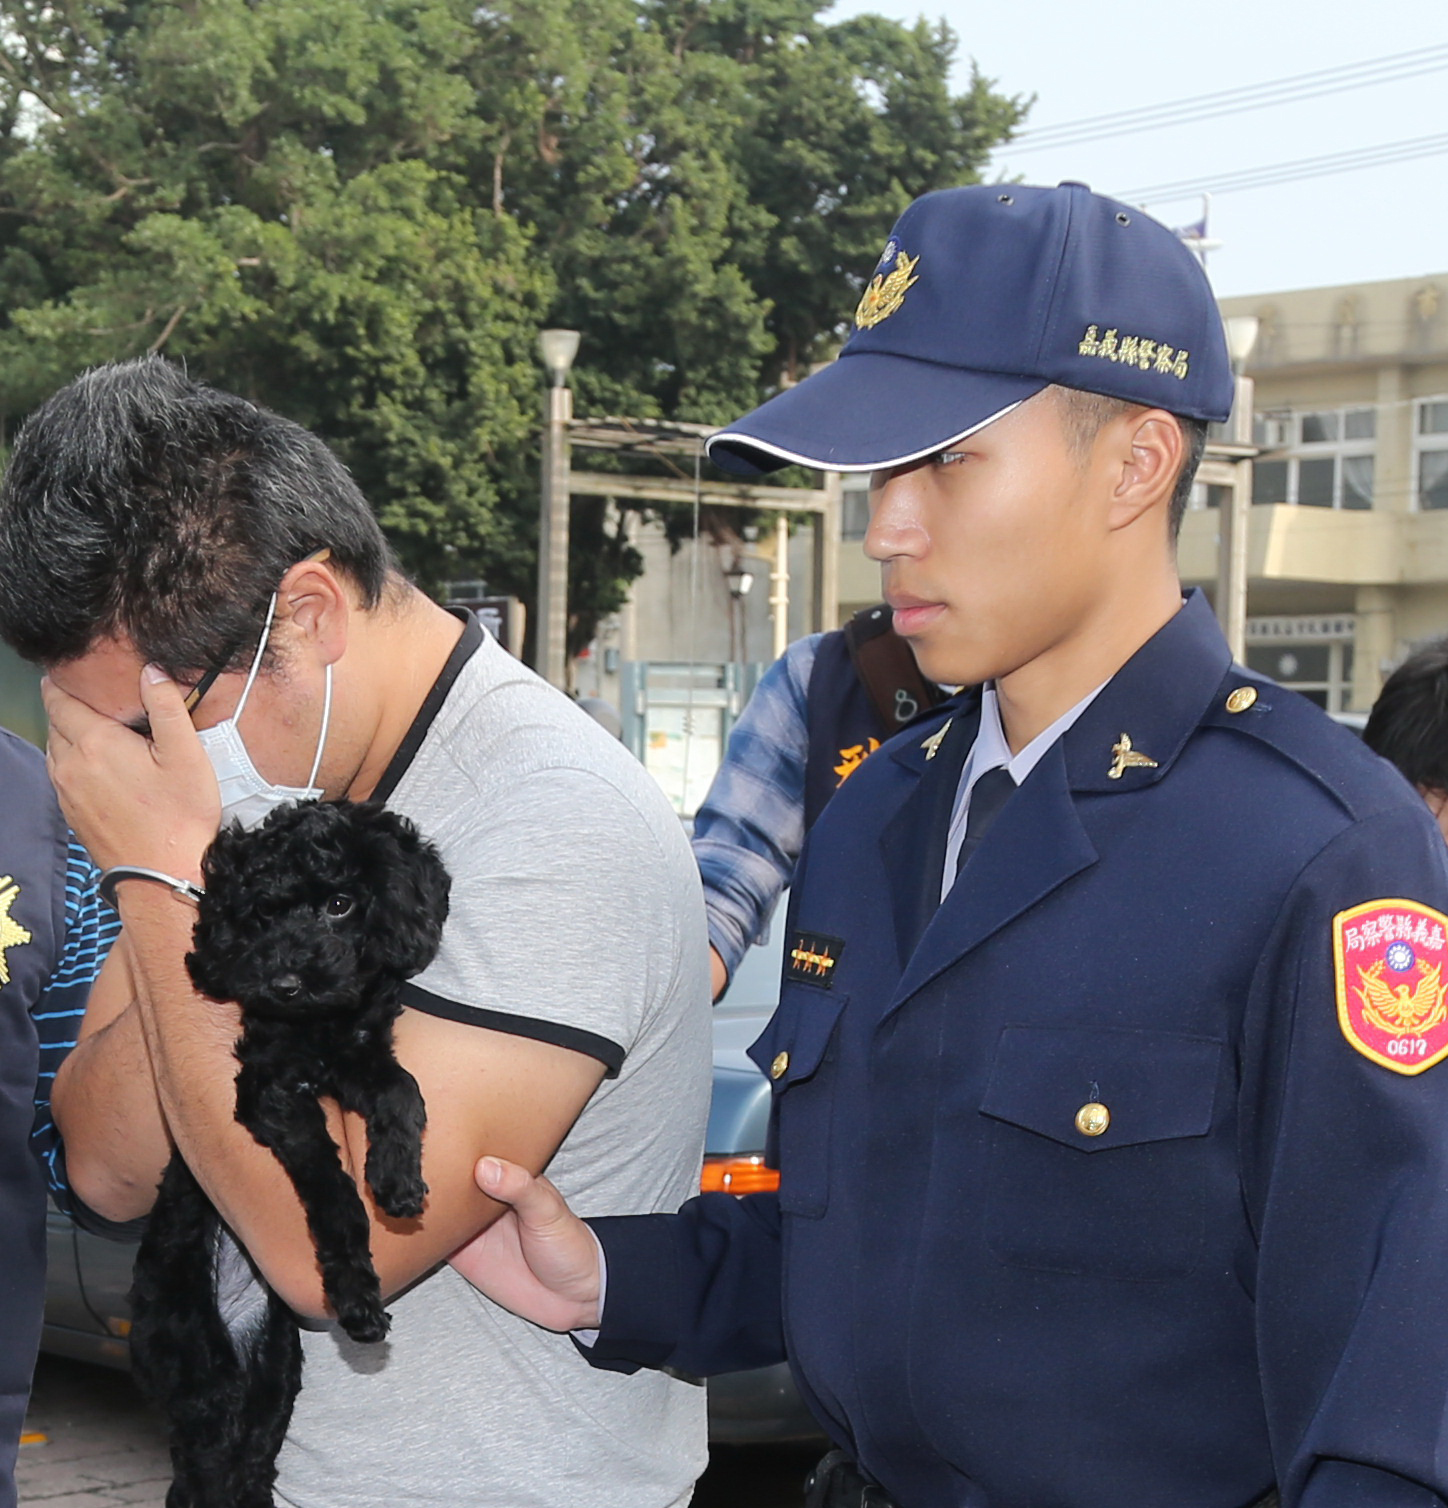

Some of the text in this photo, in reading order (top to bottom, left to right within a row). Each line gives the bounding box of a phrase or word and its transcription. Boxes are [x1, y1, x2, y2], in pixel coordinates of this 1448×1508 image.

[1078, 324, 1189, 380] 嘉義縣警察局
